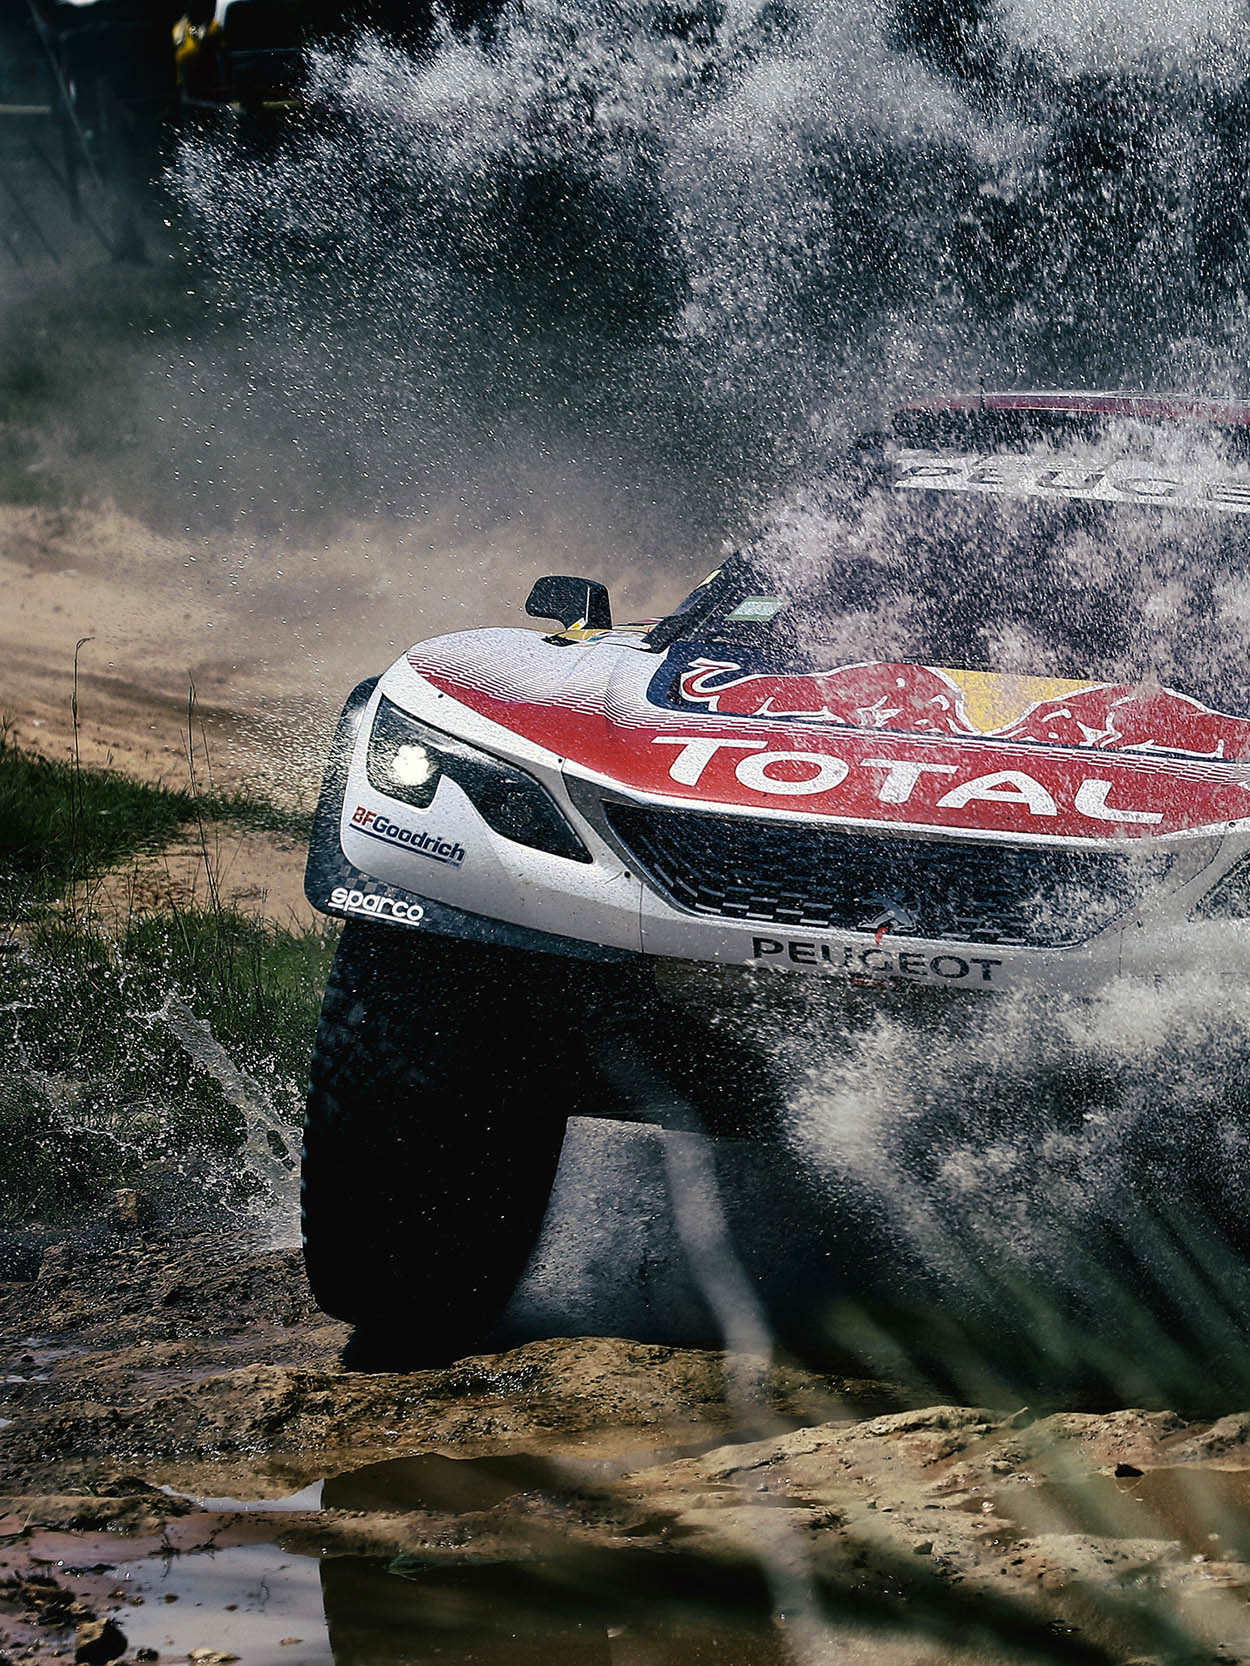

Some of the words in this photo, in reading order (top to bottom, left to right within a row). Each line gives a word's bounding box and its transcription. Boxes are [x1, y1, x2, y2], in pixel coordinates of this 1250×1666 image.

[651, 735, 1165, 825] TOTAL
[351, 805, 466, 862] BFGoodrich
[330, 887, 425, 922] sparco
[751, 936, 1002, 982] PEUGEOT
